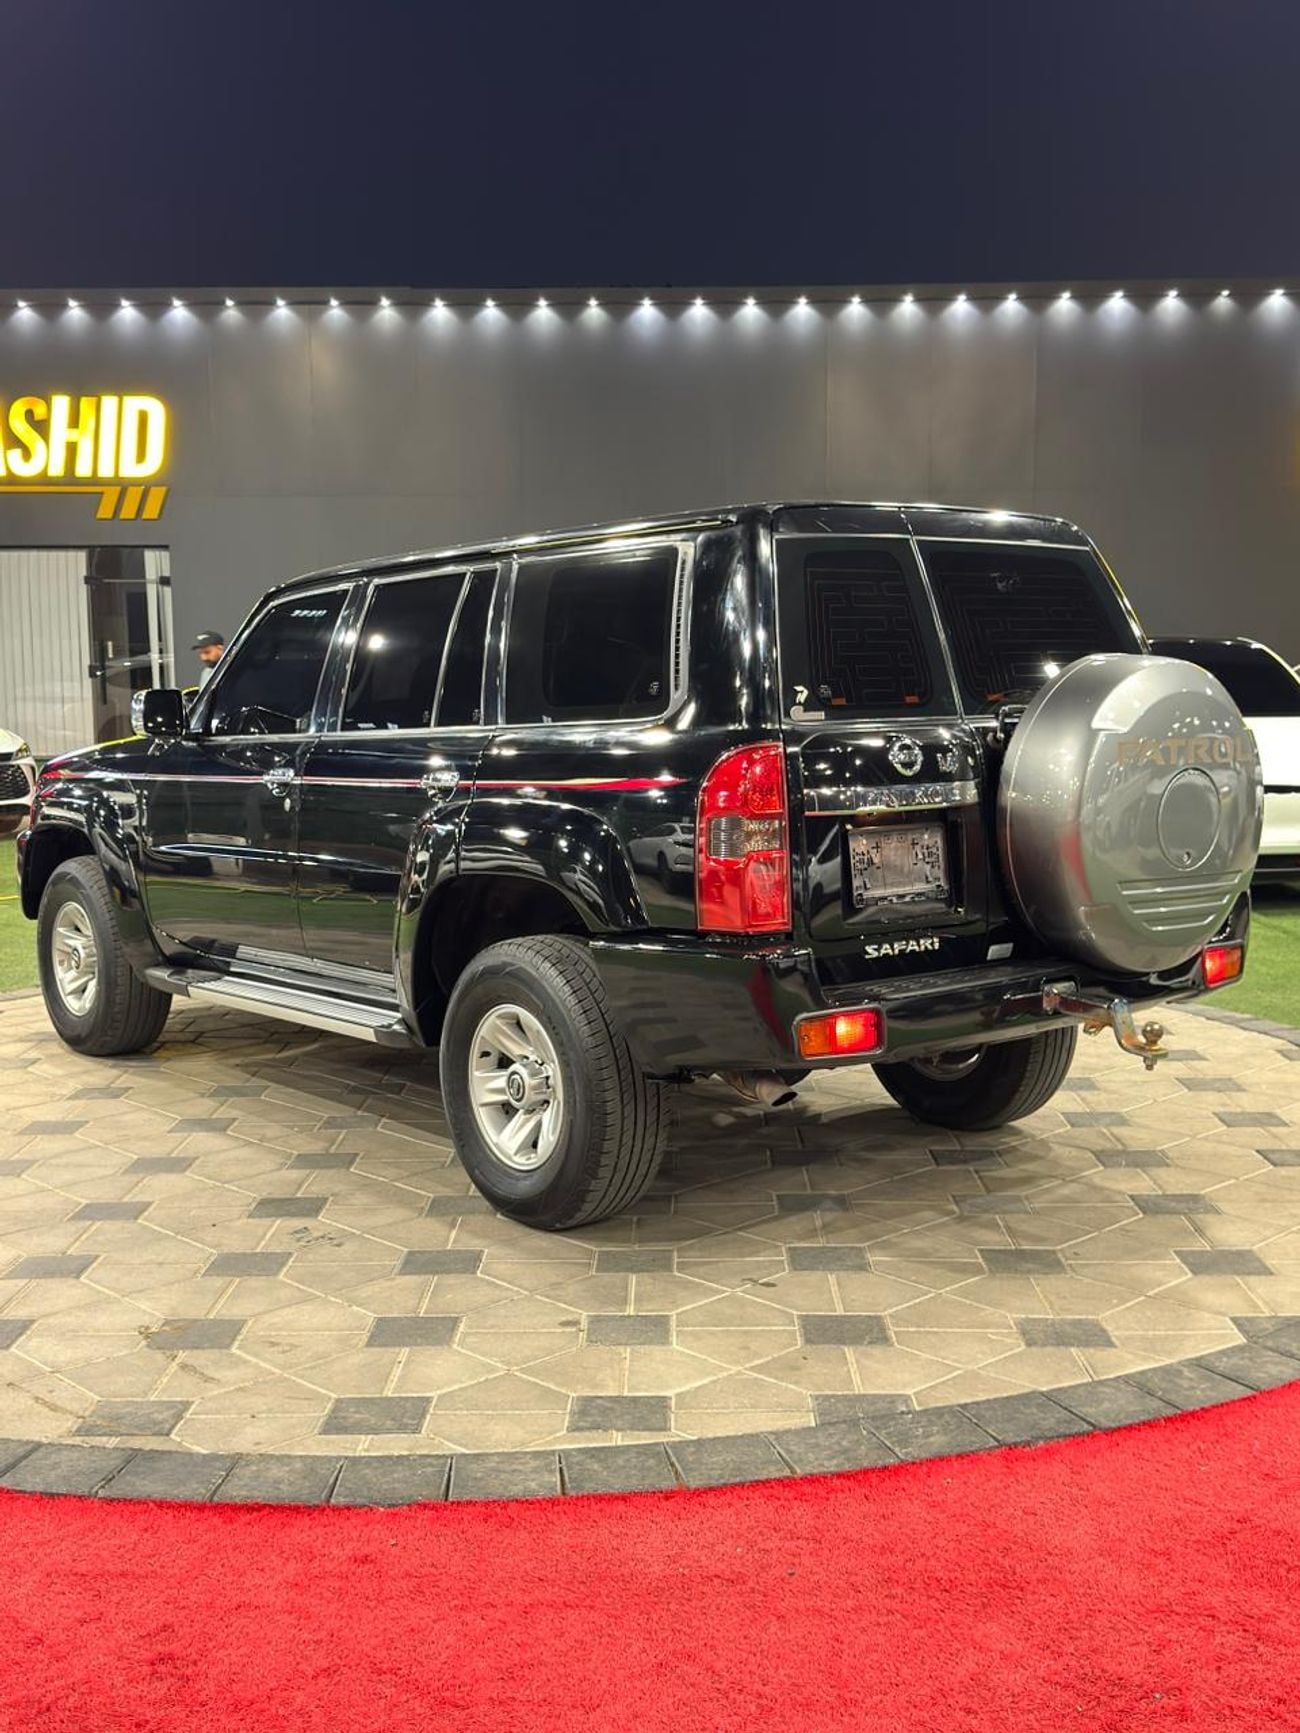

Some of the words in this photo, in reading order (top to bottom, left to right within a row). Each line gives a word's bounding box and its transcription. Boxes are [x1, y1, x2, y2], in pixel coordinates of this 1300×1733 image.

[0, 395, 167, 478] SHID
[1116, 736, 1255, 767] PATROL
[864, 937, 940, 959] SAFARI
